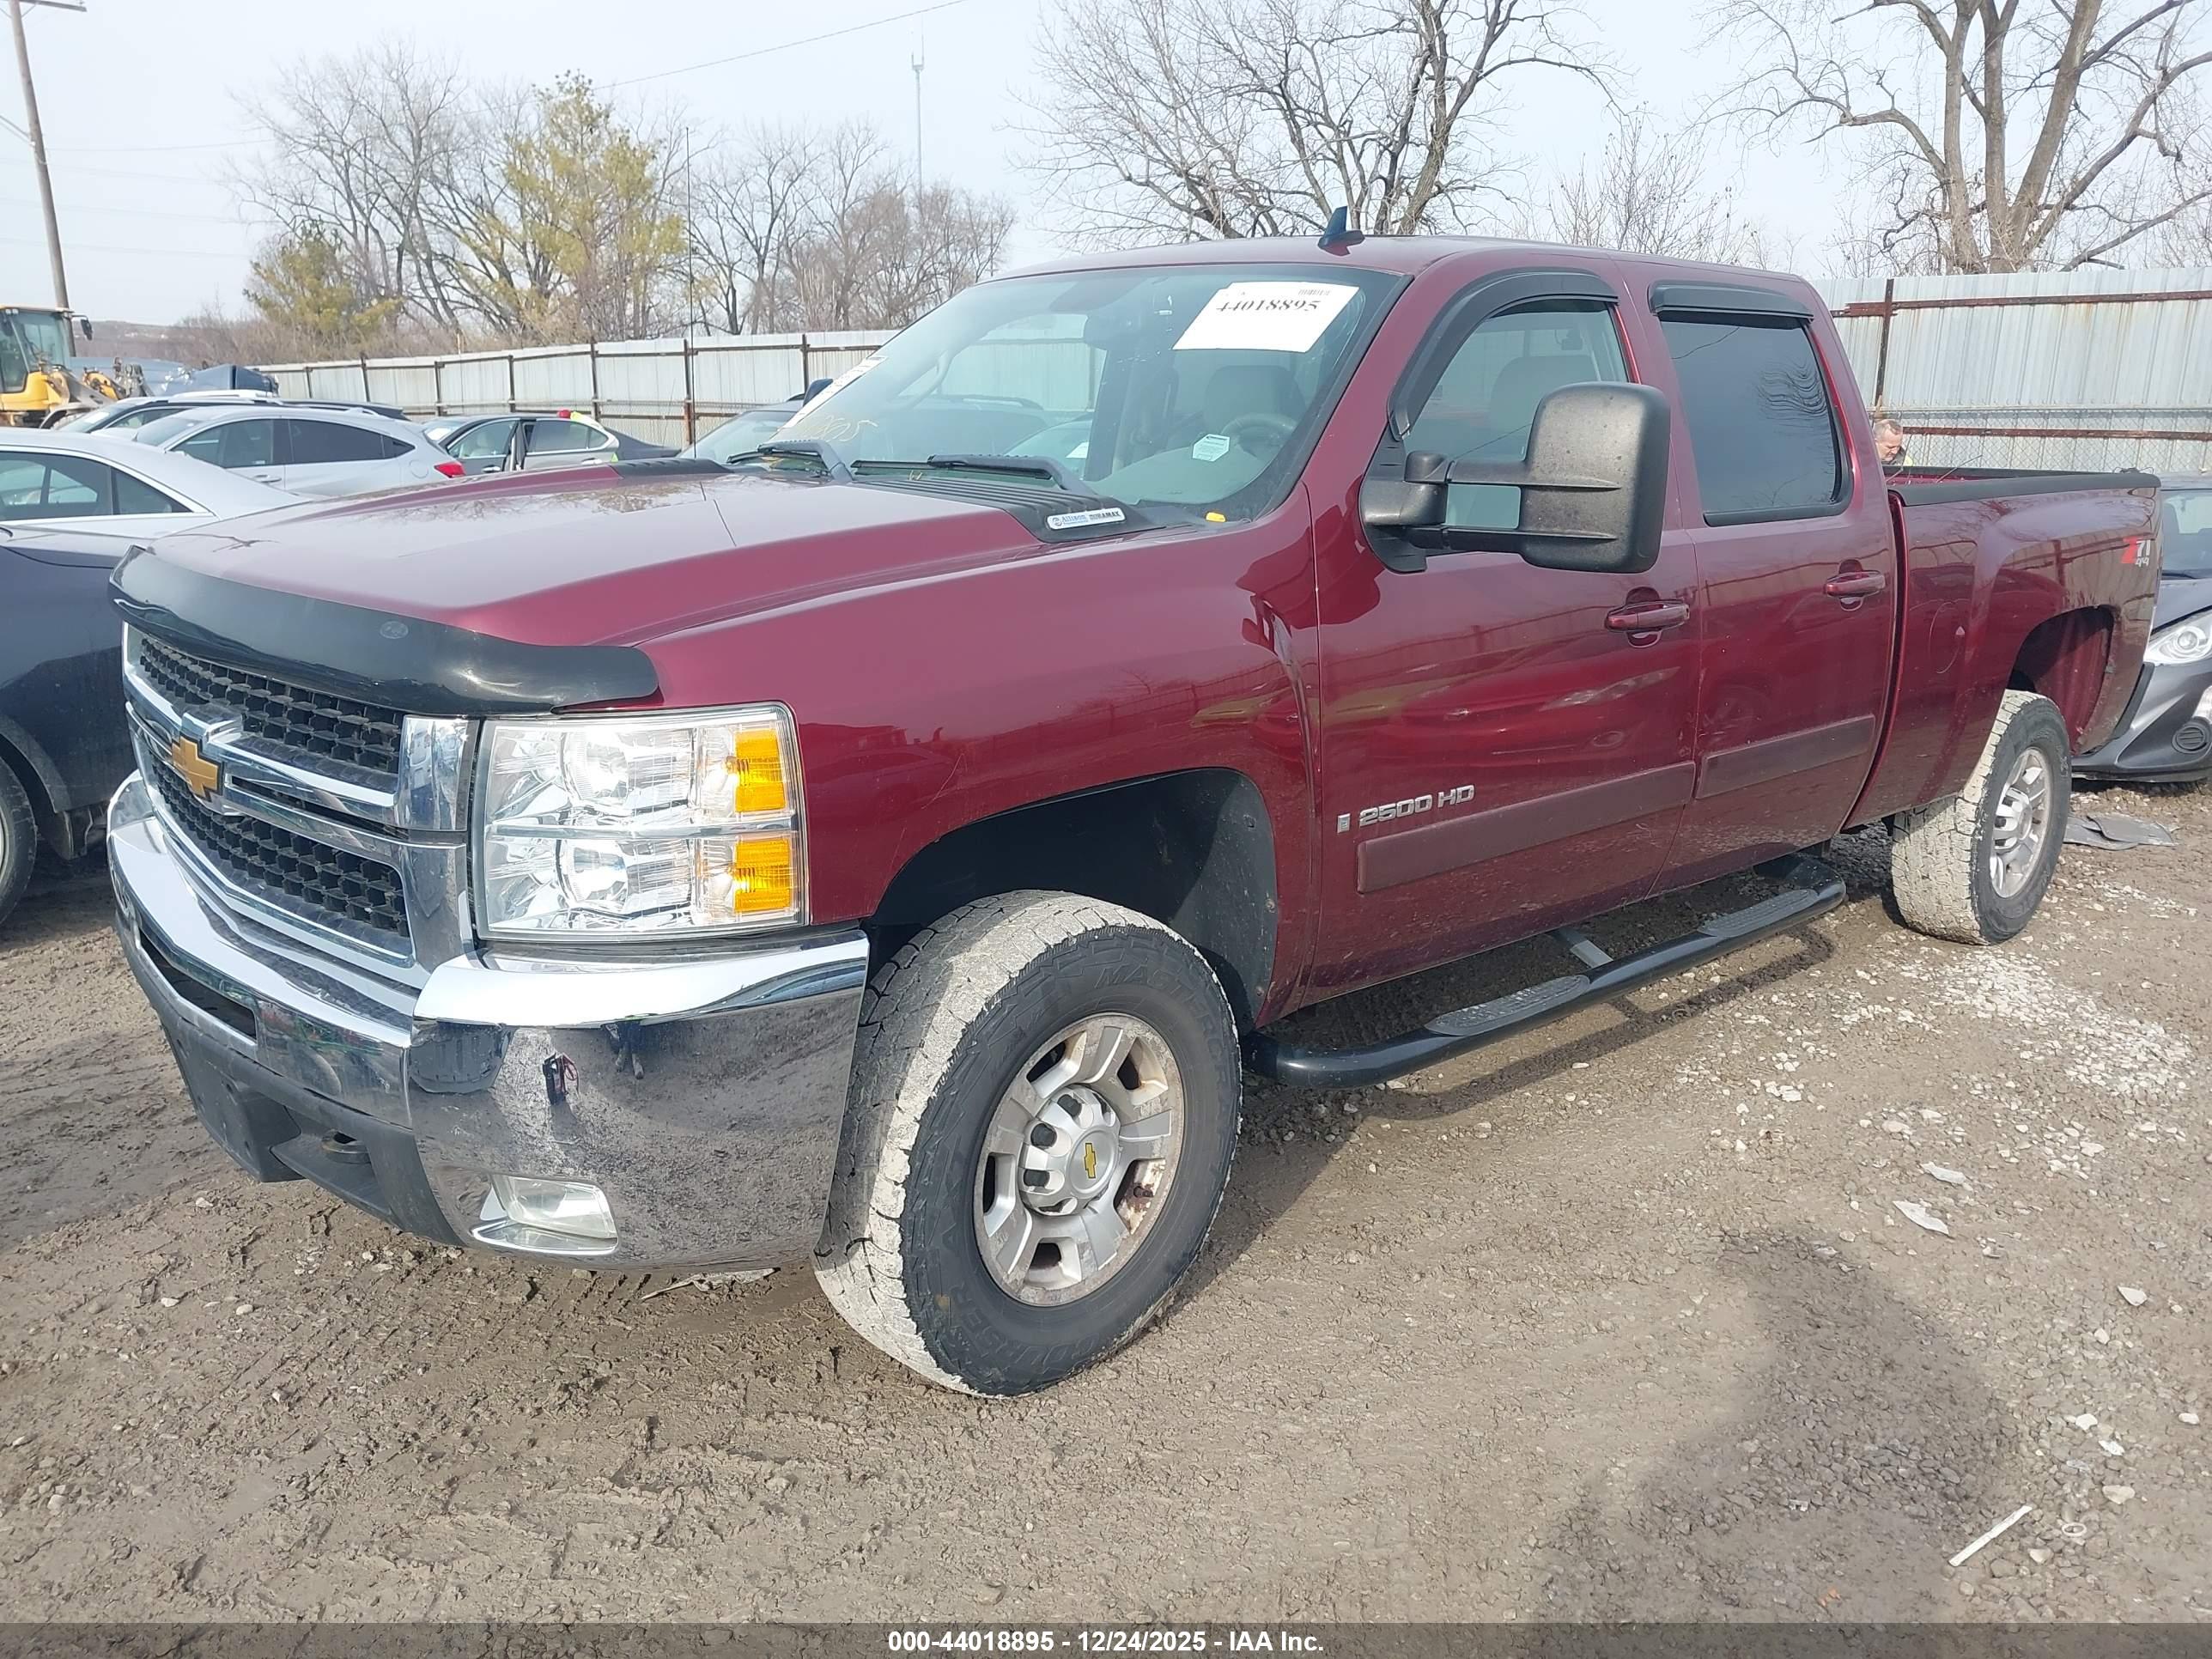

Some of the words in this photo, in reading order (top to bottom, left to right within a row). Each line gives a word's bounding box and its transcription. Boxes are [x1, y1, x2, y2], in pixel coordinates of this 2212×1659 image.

[1217, 299, 1320, 312] 44018895
[2121, 536, 2151, 564] Z71
[1359, 794, 1433, 828] 2500
[1437, 784, 1475, 808] HD
